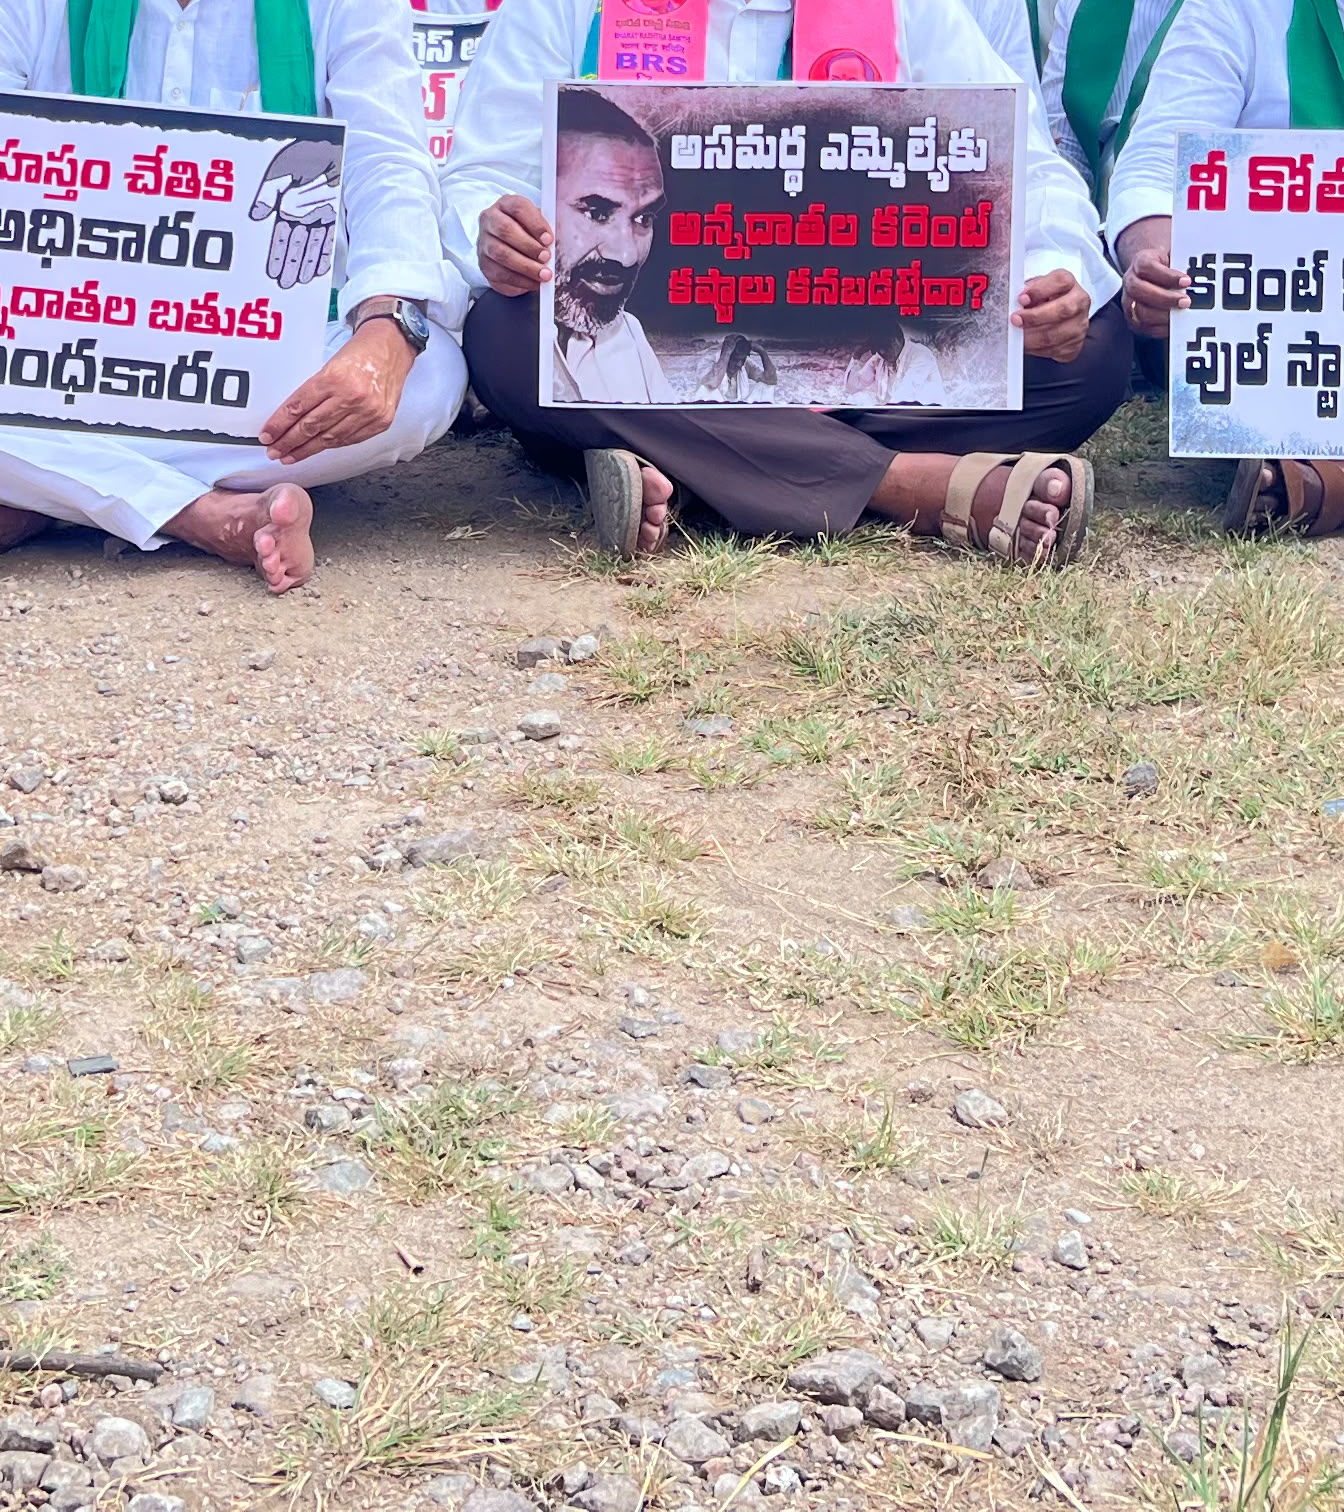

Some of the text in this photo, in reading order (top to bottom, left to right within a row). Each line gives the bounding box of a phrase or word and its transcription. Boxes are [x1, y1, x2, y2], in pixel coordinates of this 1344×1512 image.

[616, 52, 687, 74] BRS
[124, 144, 235, 203] చేతికి
[1186, 150, 1228, 212] నీ
[669, 201, 993, 260] అన్నదాతల కరెంట్
[668, 267, 775, 324] కష్టాలు
[1185, 249, 1328, 313] కరెంట్
[148, 291, 284, 341] బతుకు
